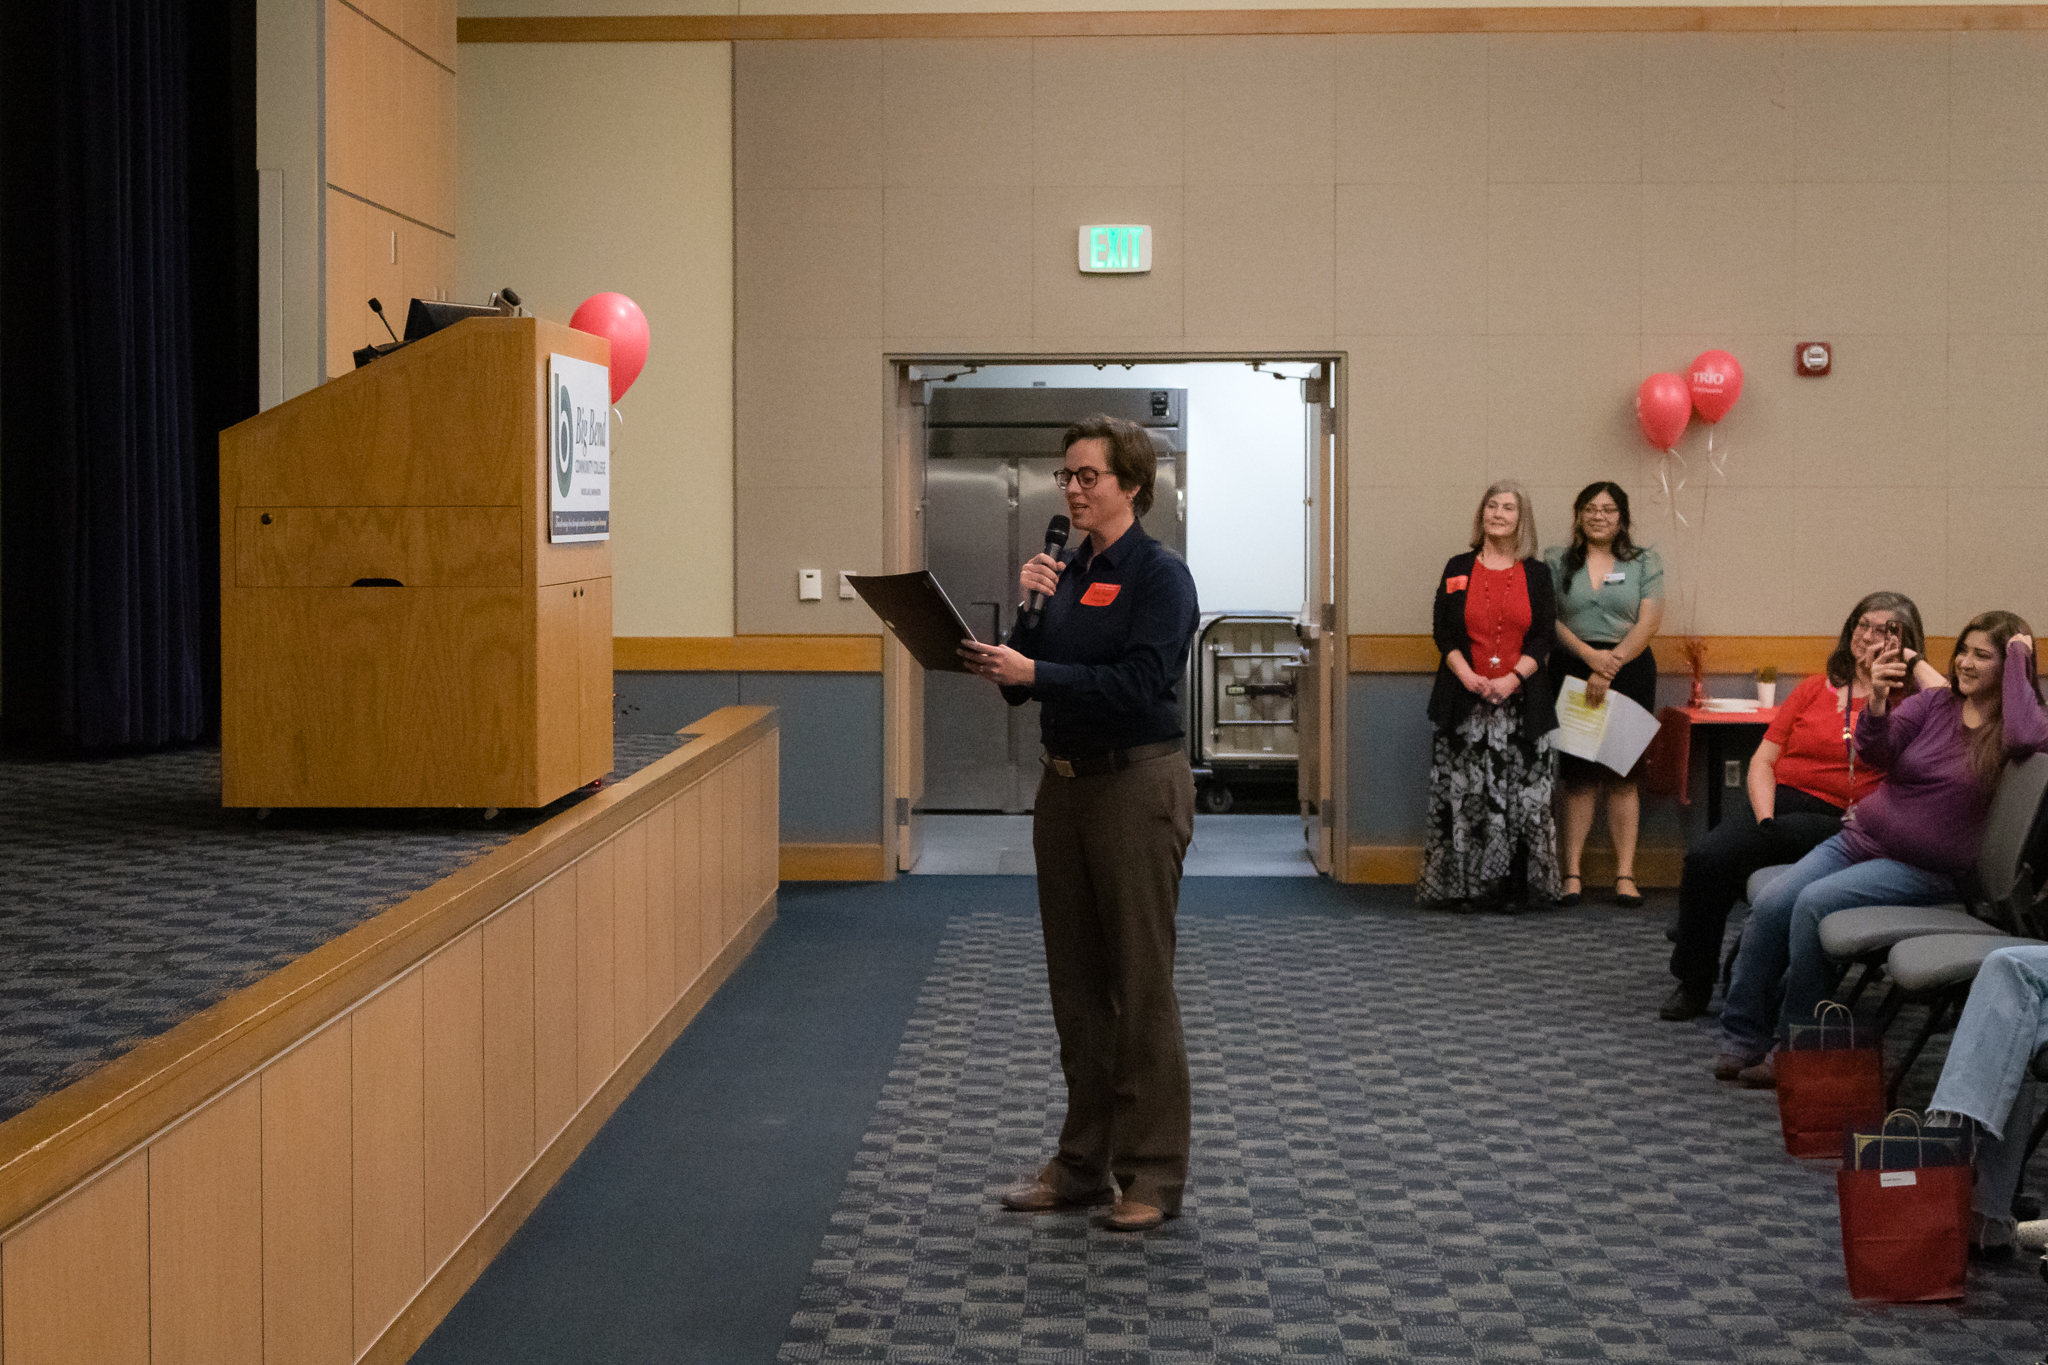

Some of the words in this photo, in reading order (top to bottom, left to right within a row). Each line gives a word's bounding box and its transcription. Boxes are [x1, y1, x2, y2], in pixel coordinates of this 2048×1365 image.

[1090, 227, 1143, 268] EXIT
[575, 407, 588, 457] Big
[588, 409, 607, 448] Bend
[593, 461, 607, 475] COLLEGE
